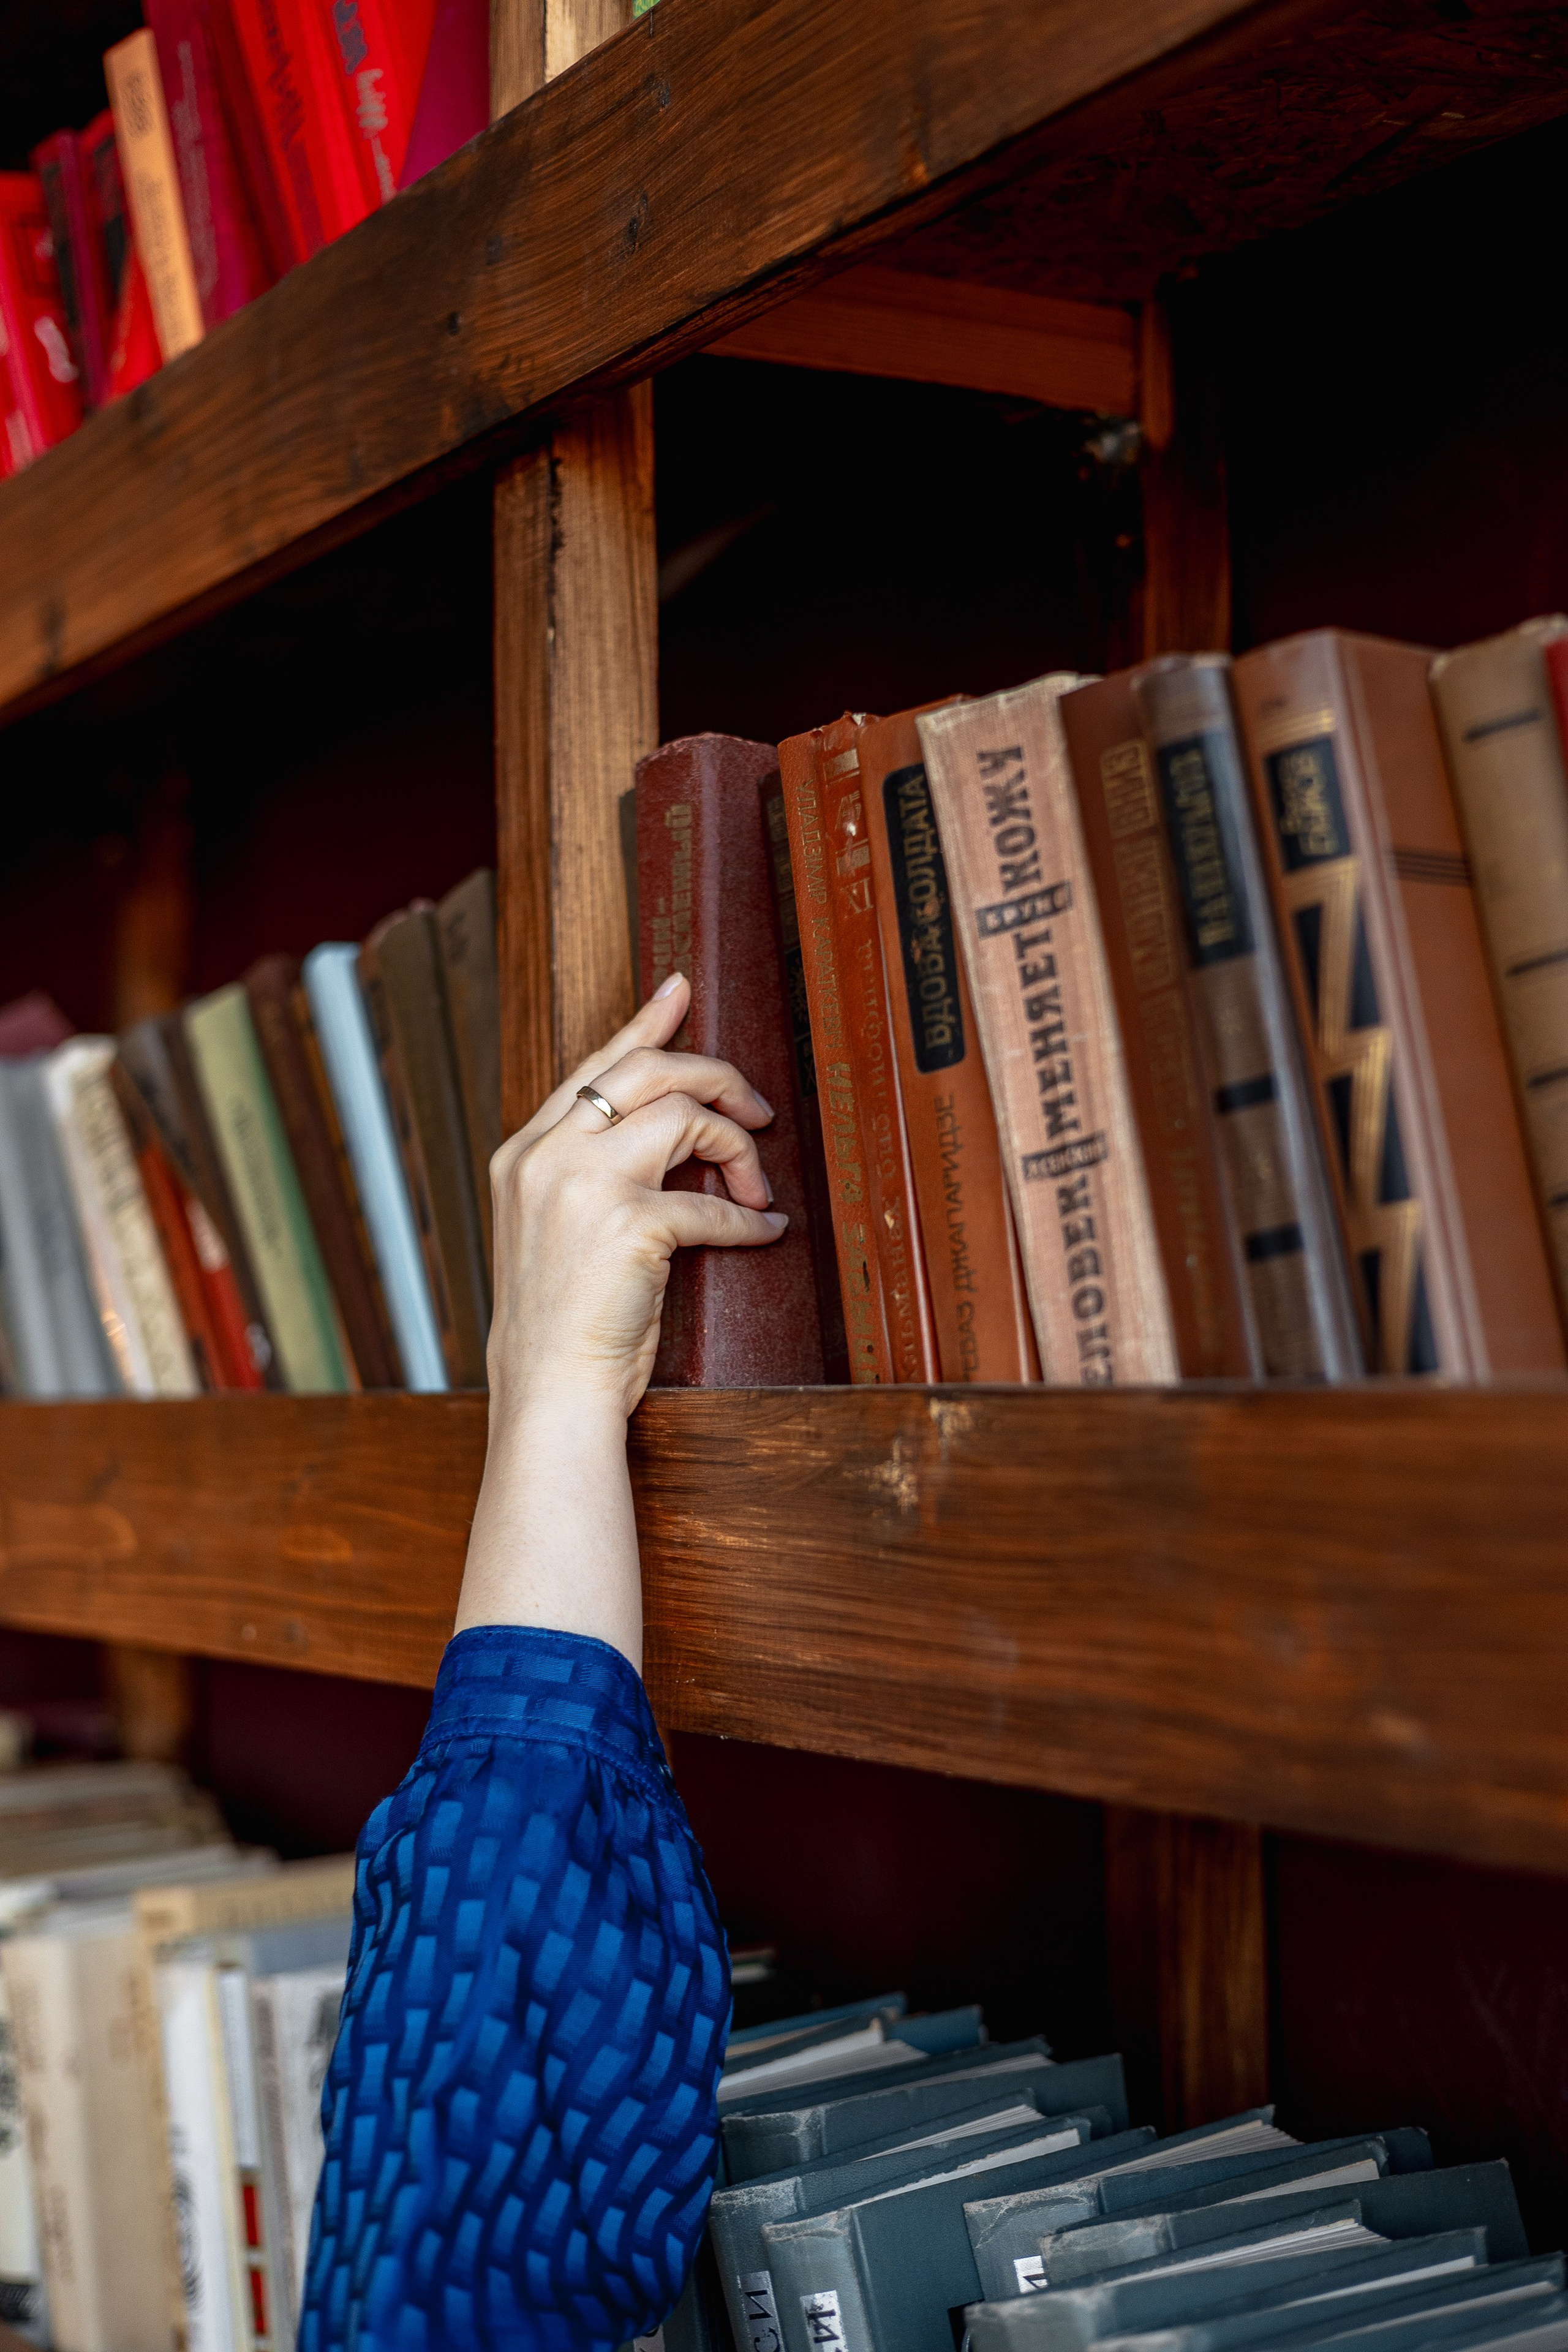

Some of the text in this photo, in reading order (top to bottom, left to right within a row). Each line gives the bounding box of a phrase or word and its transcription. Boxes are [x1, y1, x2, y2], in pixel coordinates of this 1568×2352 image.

[796, 779, 828, 905] УЛАДЗІМІР
[897, 774, 952, 1049] ВДОВА СОЛДАТА
[810, 917, 843, 1049] КАРАТКЕВІЧ
[976, 746, 1114, 1384] ЕЛОВЕК МЕНЯЕТ КОЖУ
[827, 1061, 864, 1204] НЕЛЬГА
[934, 1093, 980, 1384] ЕВАЗ ДЖАПАРИДЗЕ
